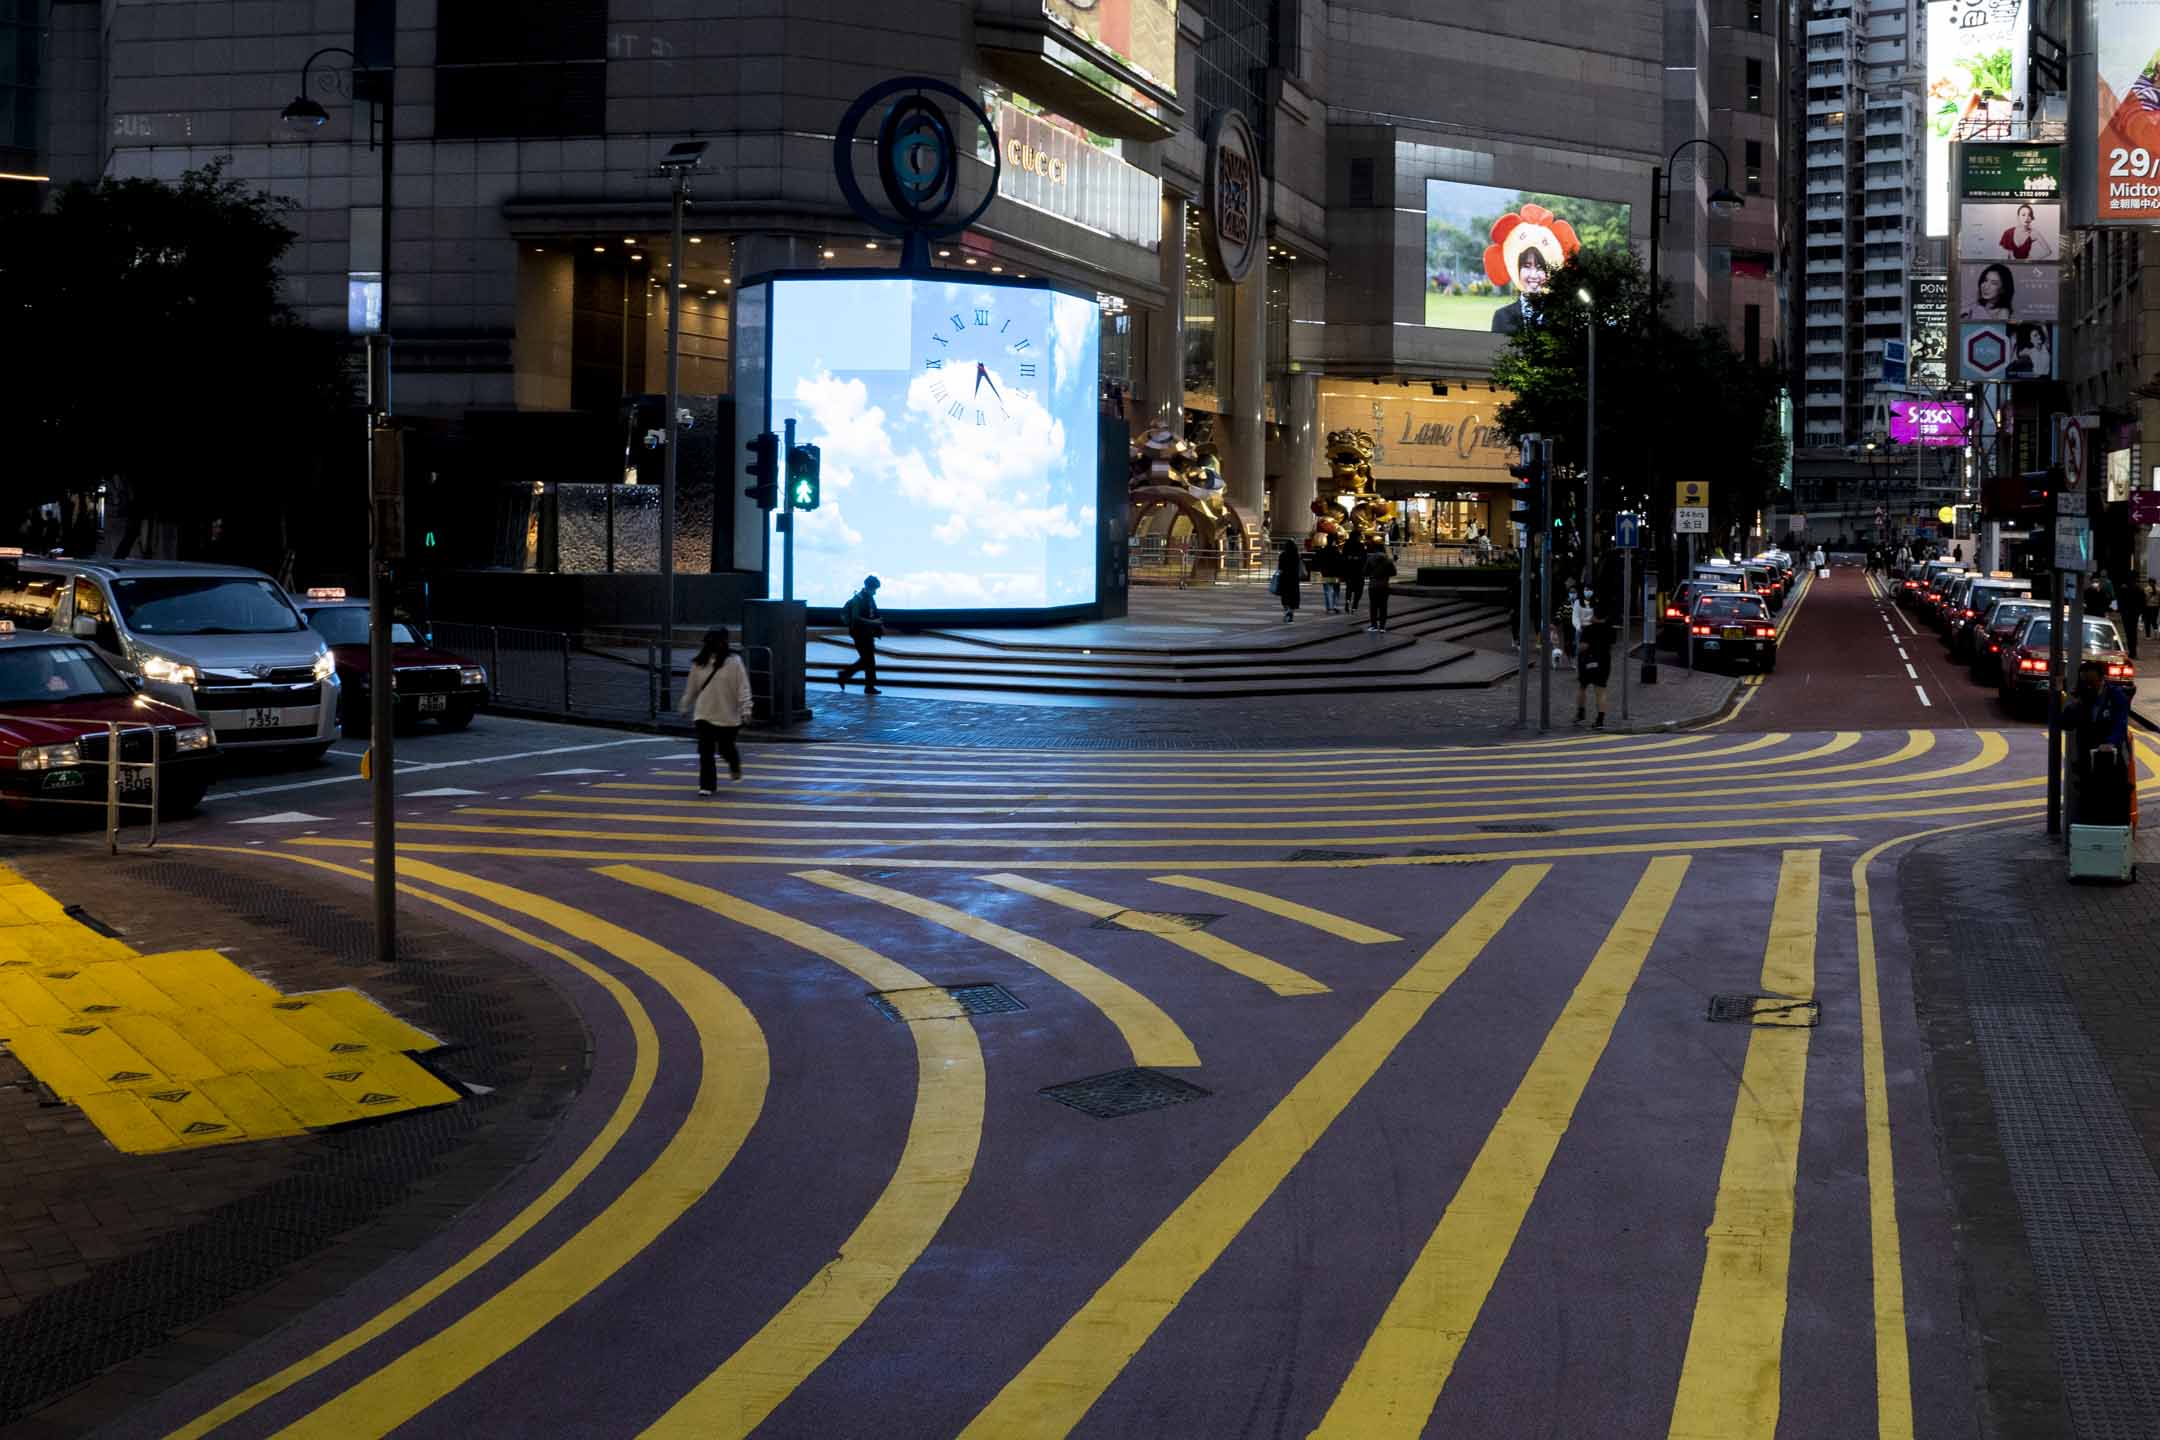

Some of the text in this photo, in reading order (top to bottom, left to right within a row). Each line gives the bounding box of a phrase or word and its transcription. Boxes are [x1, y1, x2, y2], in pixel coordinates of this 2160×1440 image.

[1007, 138, 1067, 186] GUCCI
[2110, 183, 2160, 197] Midto
[974, 309, 989, 326] XII
[1020, 363, 1036, 377] III
[1398, 411, 1455, 447] Lane
